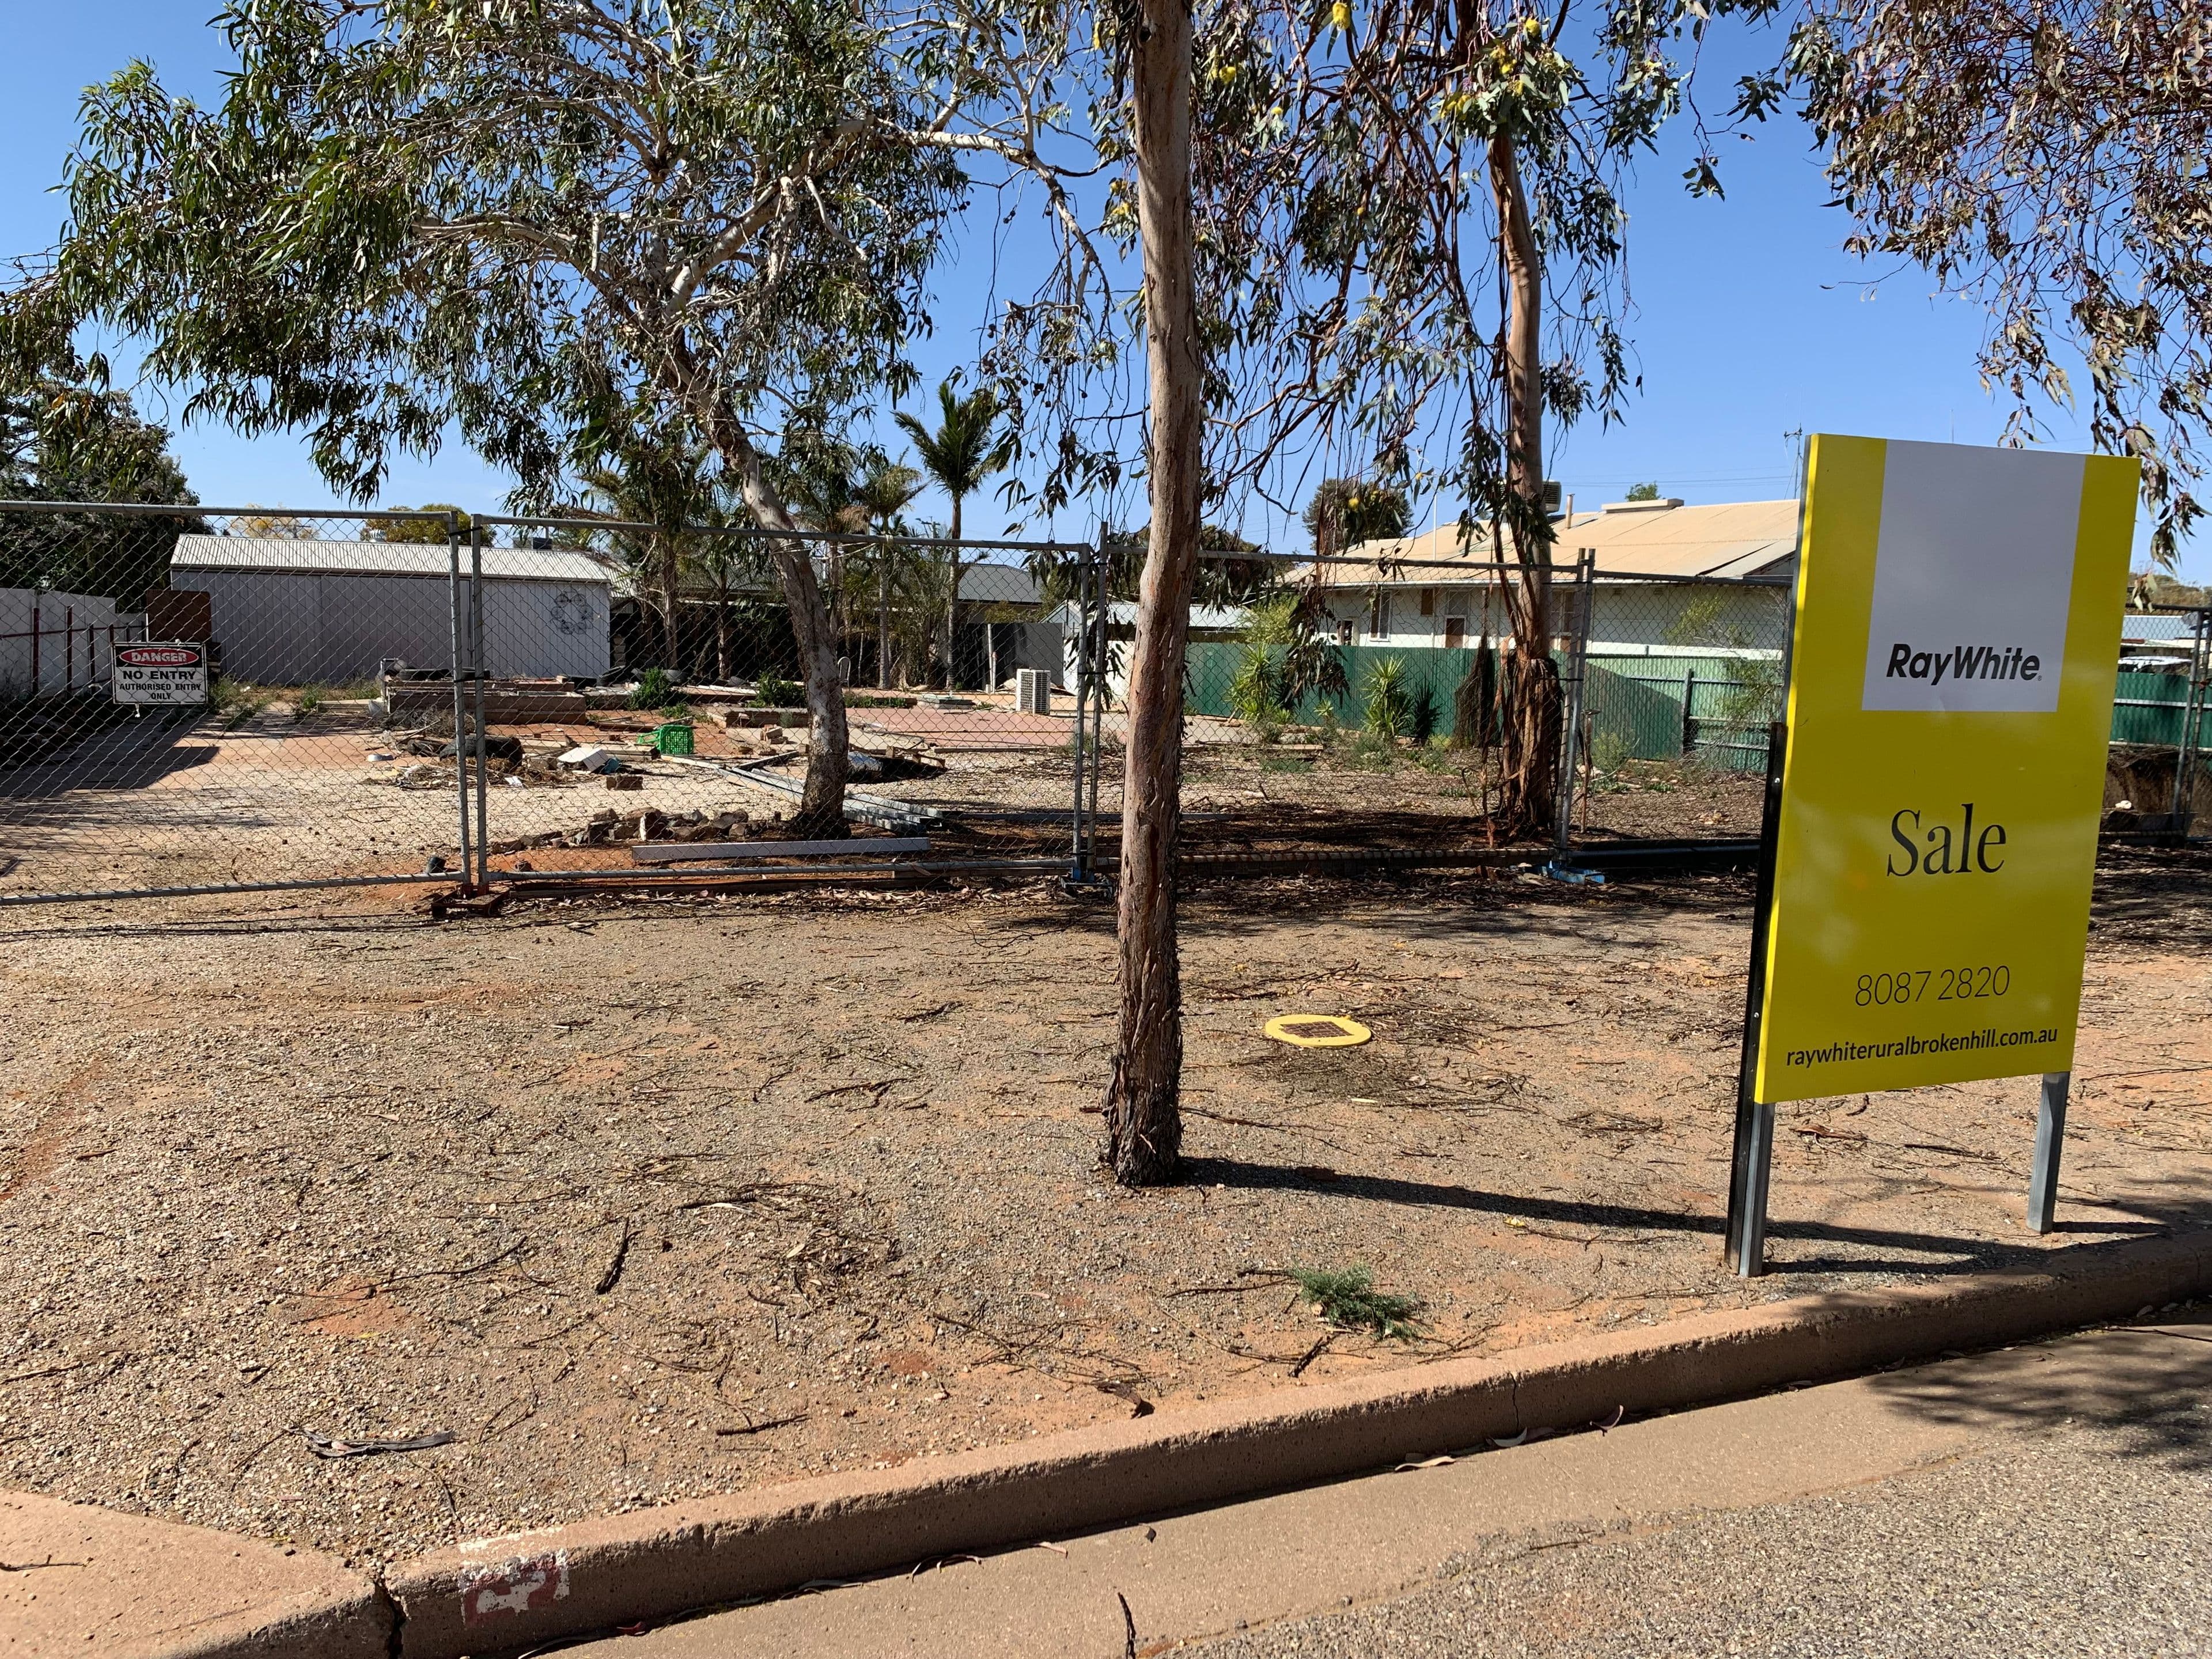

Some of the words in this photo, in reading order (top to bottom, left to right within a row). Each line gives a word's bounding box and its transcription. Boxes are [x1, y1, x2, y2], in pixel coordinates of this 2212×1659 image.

[123, 671, 143, 680] NO
[150, 671, 196, 680] ENTRY
[131, 652, 187, 662] DANGER
[1887, 802, 2006, 877] Sale
[1855, 970, 1931, 1006] 8087
[1937, 965, 2010, 1000] 2820
[1786, 1028, 2058, 1069] raywhiteruralbrokenhill.com.au
